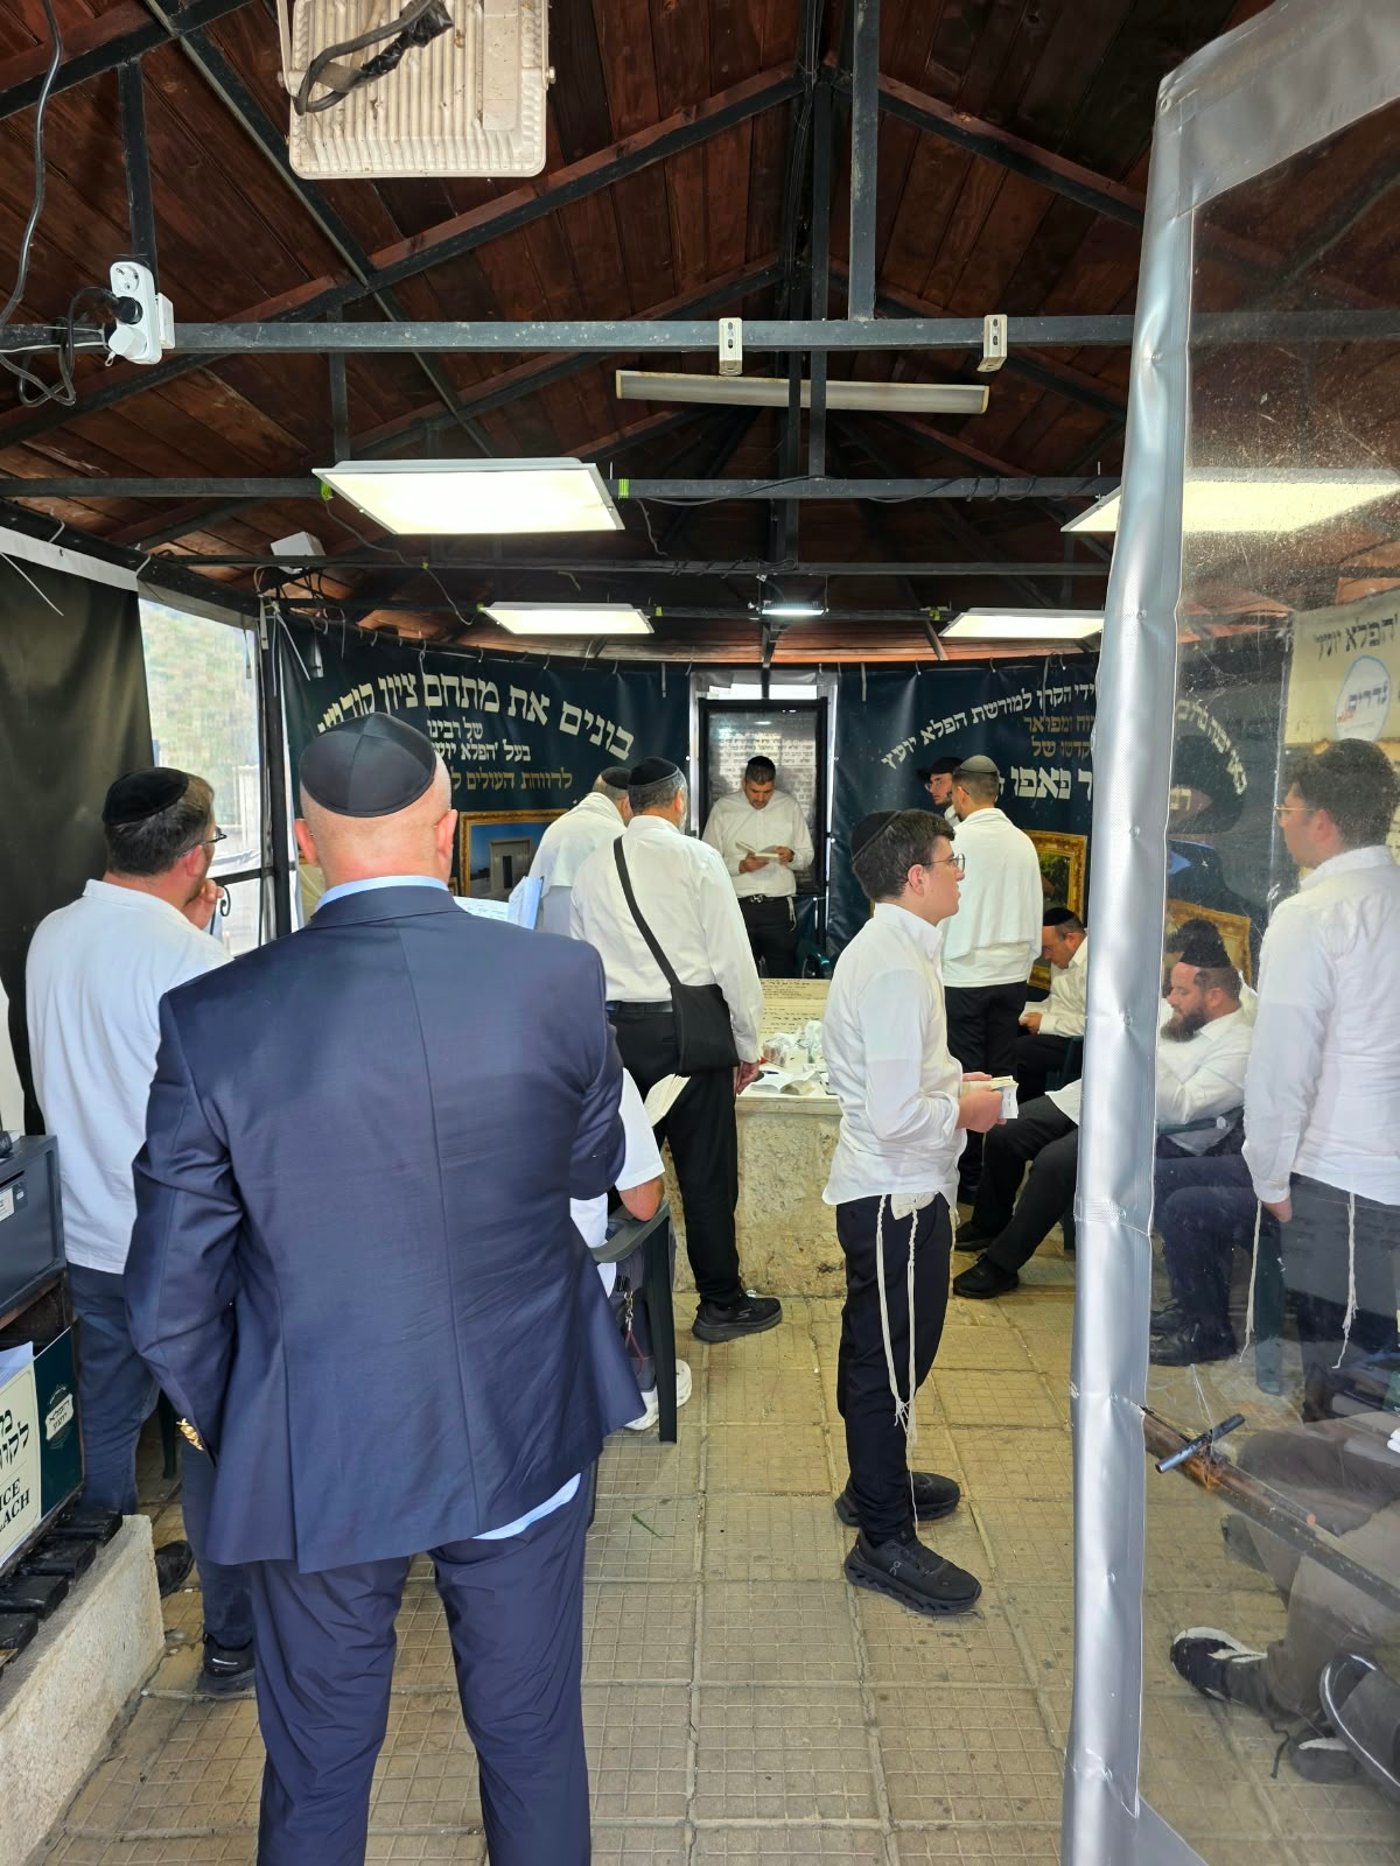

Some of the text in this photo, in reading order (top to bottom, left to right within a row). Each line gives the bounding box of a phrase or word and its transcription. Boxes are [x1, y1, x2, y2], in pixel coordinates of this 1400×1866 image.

[378, 673, 418, 715] ציון
[422, 673, 499, 713] מתחם
[507, 684, 550, 726] את
[971, 688, 1032, 724] למורשת
[1036, 686, 1071, 710] הקרן
[462, 716, 483, 739] של
[559, 701, 634, 761] בונים
[920, 712, 968, 745] הפלא
[1023, 715, 1072, 733] ומפואר
[432, 741, 456, 760] יוע
[502, 739, 531, 761] בעל
[881, 736, 917, 769] יועץ
[1031, 735, 1057, 757] של
[465, 767, 514, 790] העולים
[521, 767, 572, 789] לרווחת
[1010, 766, 1071, 799] פאפו
